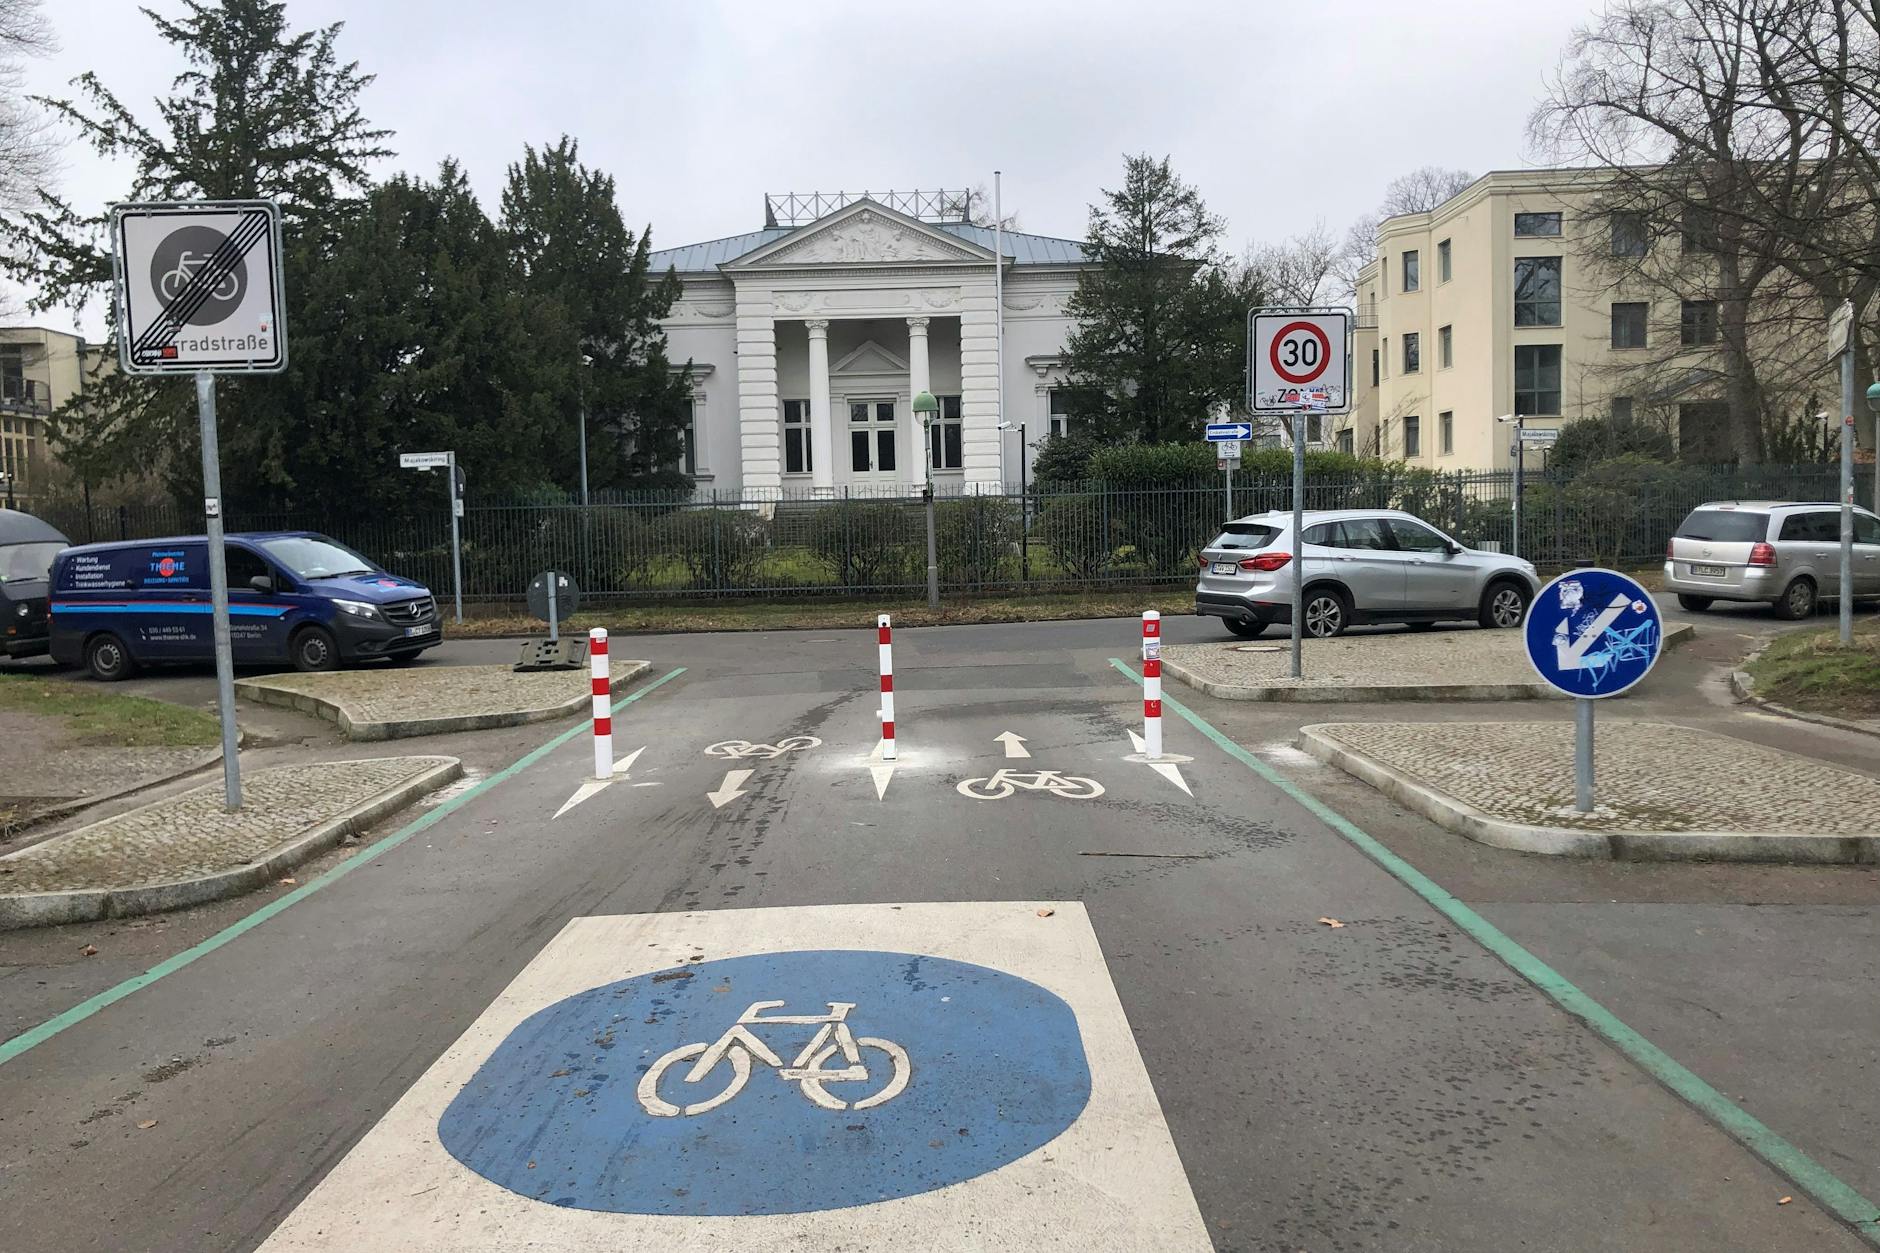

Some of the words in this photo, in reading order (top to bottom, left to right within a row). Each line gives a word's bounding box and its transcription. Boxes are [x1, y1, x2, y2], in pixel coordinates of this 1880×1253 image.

[141, 334, 268, 353] rradstraße
[1283, 338, 1318, 367] 30
[150, 562, 185, 571] THIEME
